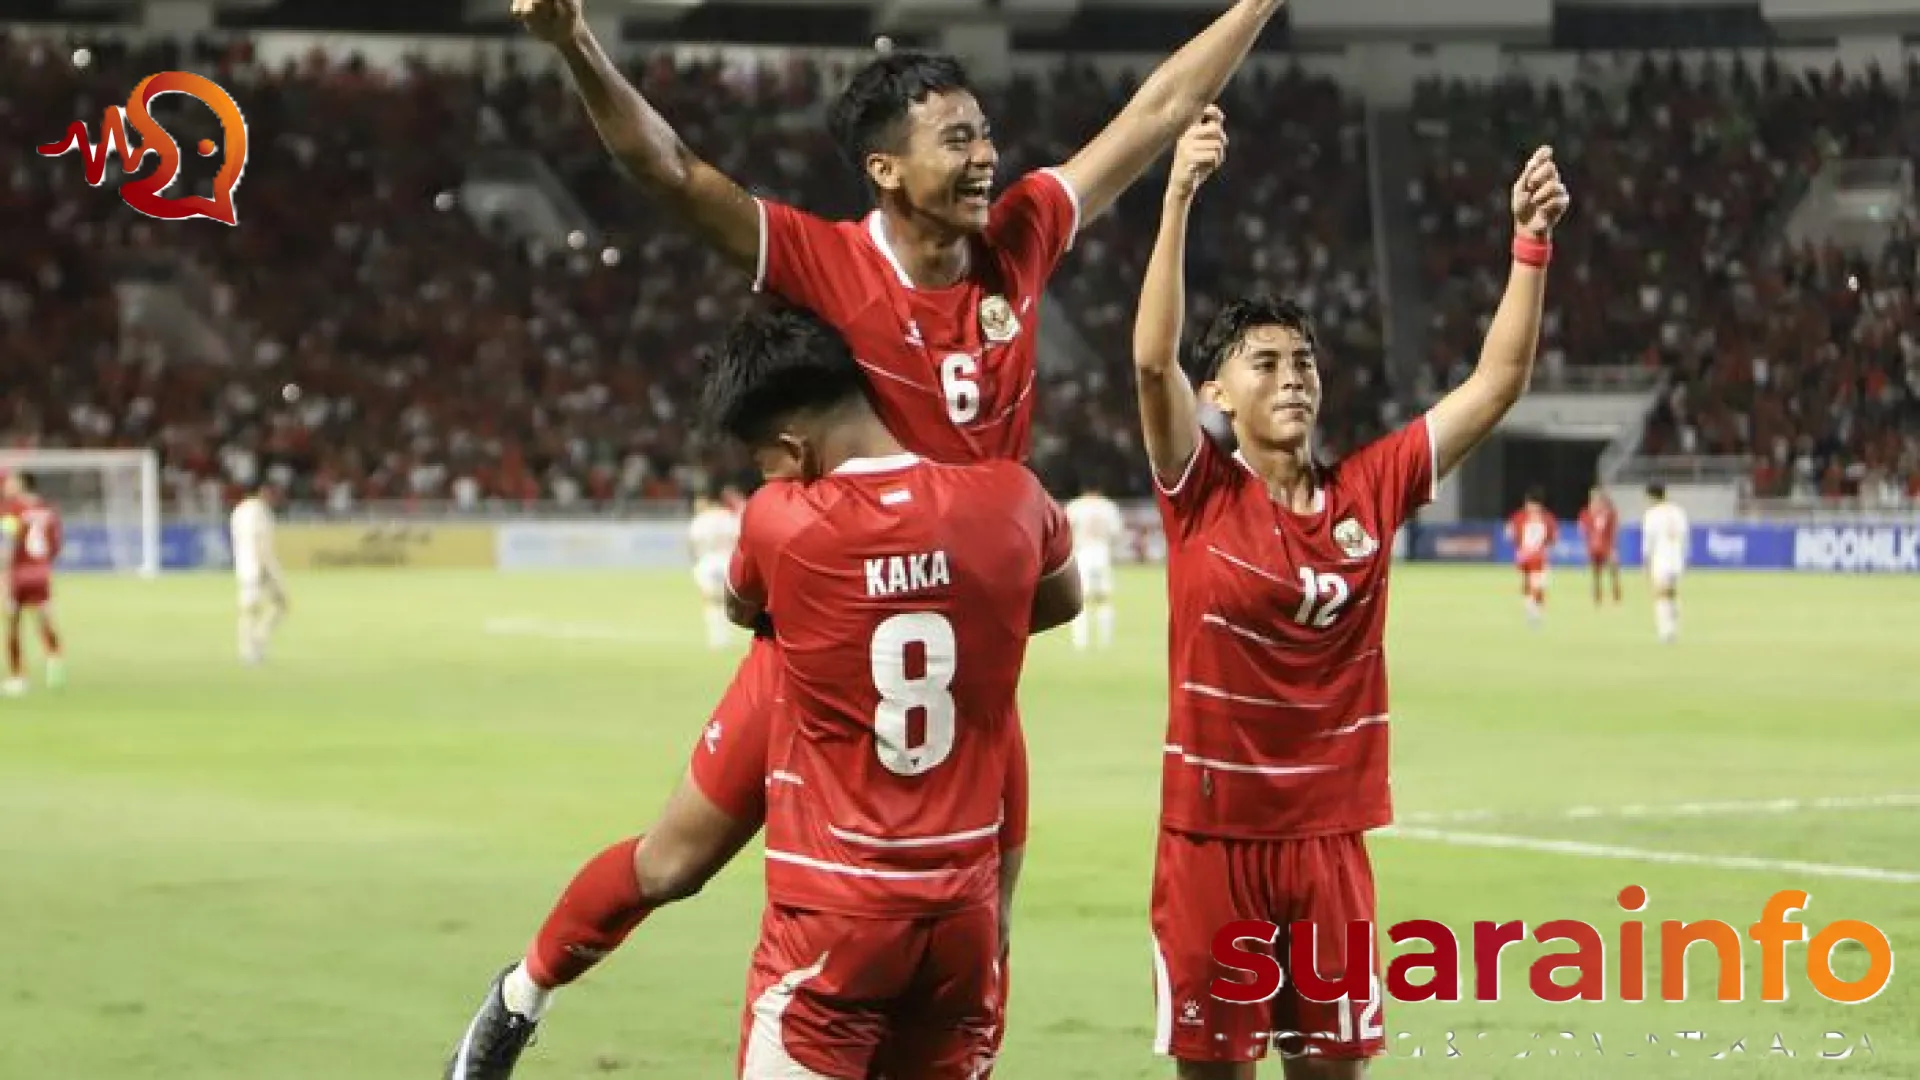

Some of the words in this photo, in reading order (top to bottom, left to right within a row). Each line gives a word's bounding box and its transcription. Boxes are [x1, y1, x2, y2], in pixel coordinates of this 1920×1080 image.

[941, 352, 980, 423] 6
[864, 550, 950, 597] KAKA
[1294, 566, 1348, 627] 12
[871, 612, 957, 777] 8
